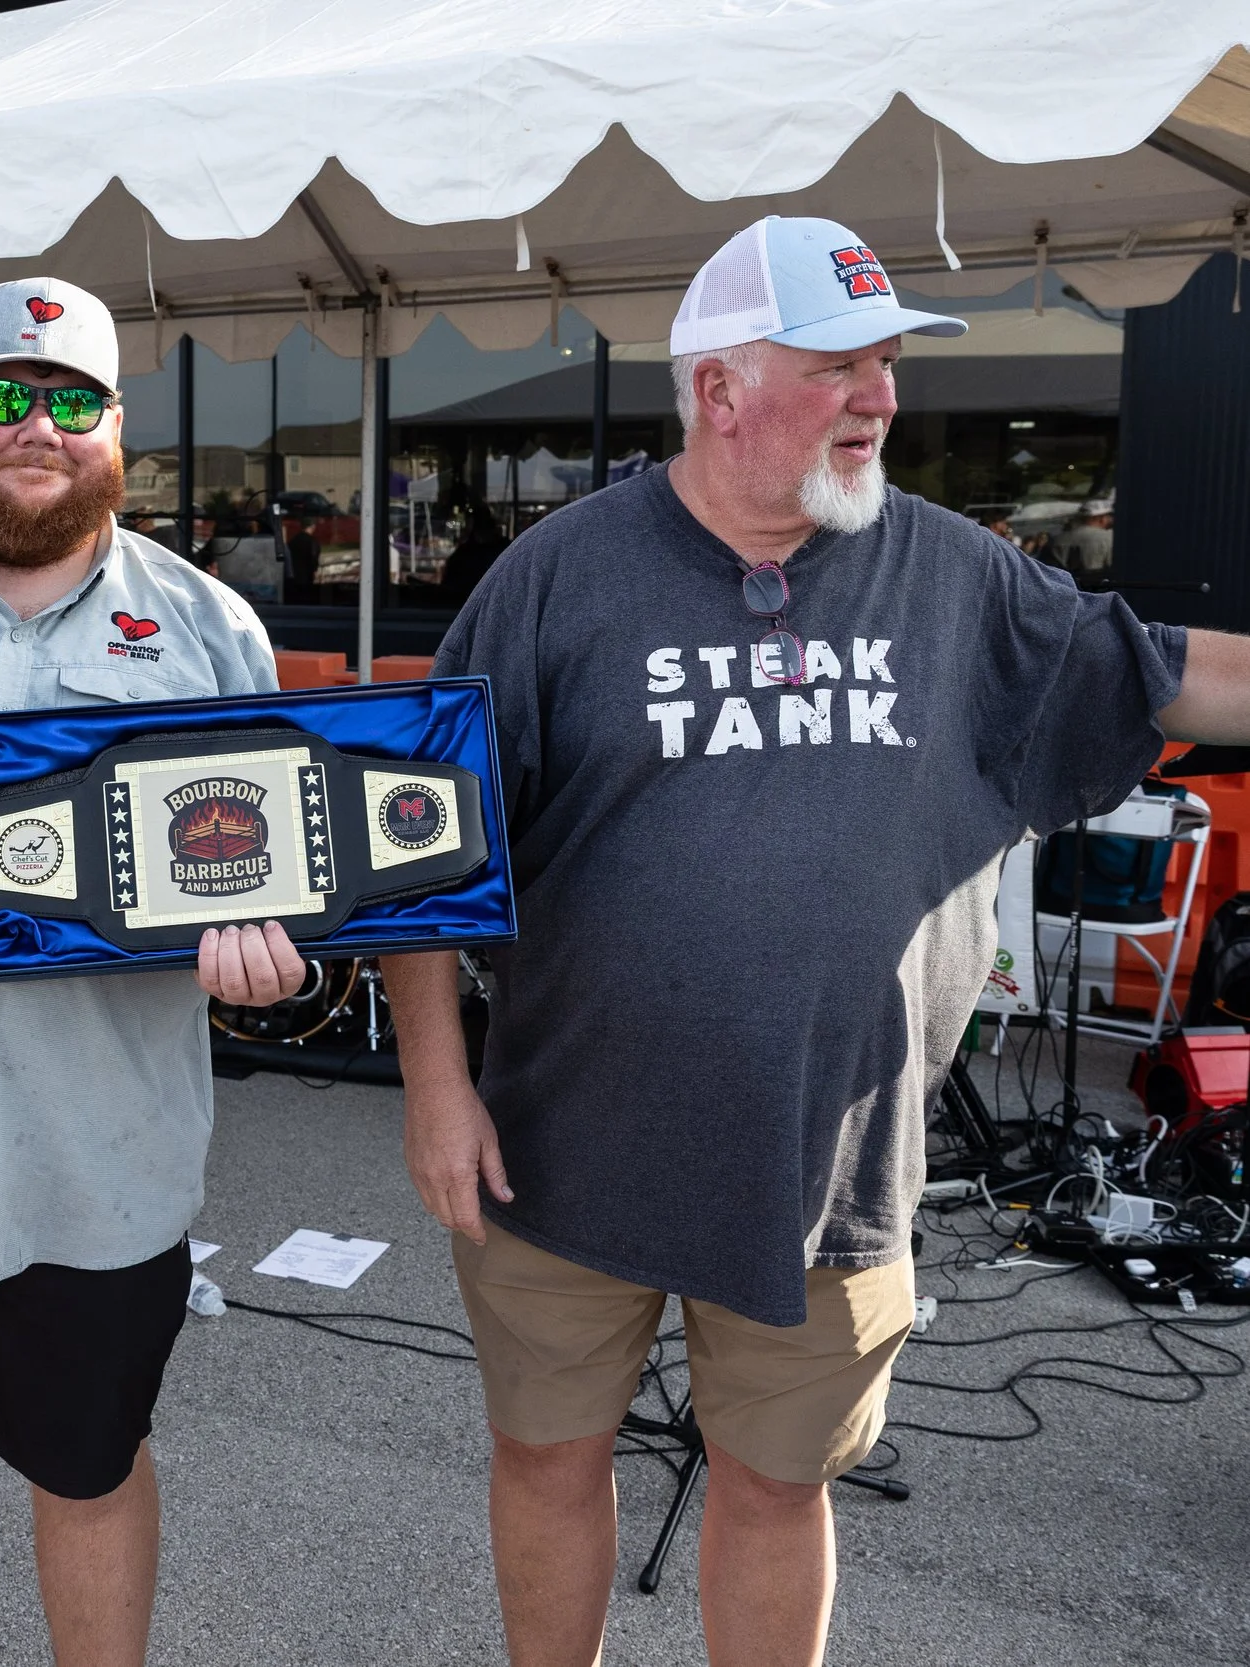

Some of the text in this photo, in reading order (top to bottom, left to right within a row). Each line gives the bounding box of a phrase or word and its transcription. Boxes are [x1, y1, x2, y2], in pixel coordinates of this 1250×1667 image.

[837, 262, 883, 279] NORTHWE
[107, 641, 160, 656] OPERATION
[107, 648, 160, 663] BBQ RELIEF
[646, 637, 896, 692] STEAK
[168, 780, 263, 812] BOURBON
[11, 855, 34, 863] Chef's
[174, 855, 269, 880] BARBECUE
[185, 876, 260, 893] AND MAYHEM
